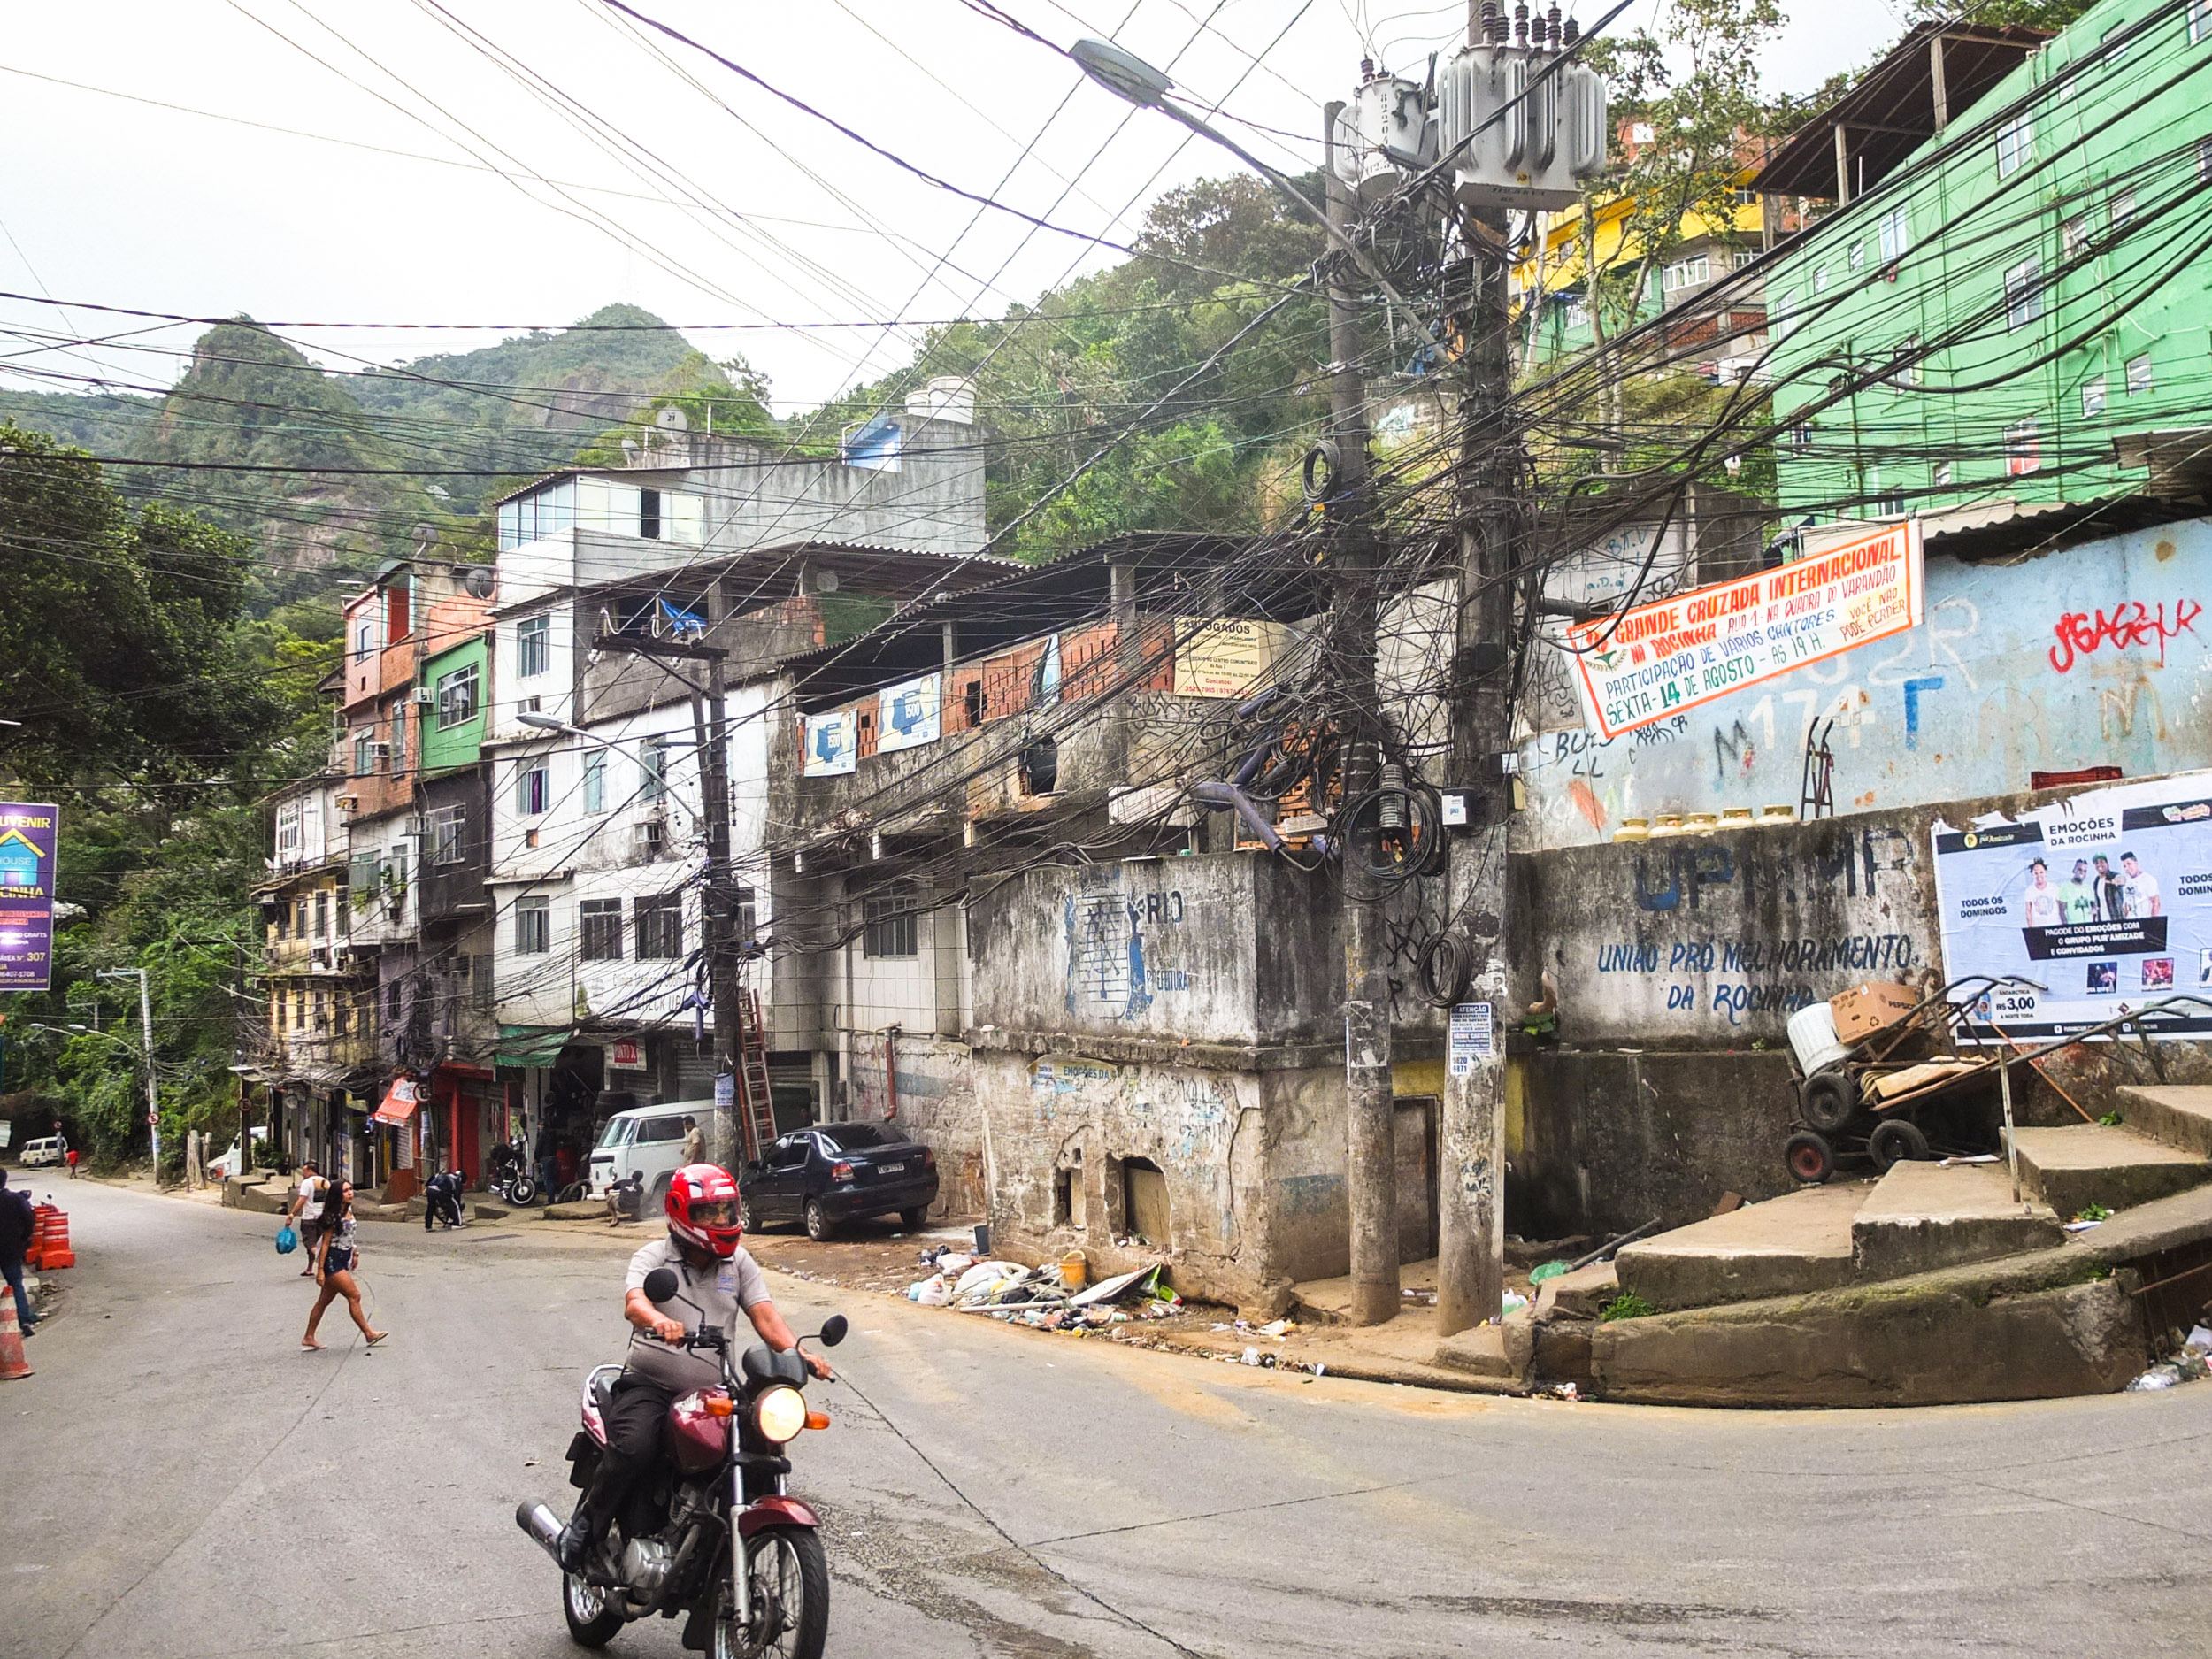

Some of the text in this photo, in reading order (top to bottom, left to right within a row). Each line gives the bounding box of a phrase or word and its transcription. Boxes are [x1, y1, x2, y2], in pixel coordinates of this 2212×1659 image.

[1614, 536, 1902, 645] GRANDE CRUZADA INTERNACIONAL
[1848, 587, 1898, 620] VOCÊ NÃO
[1630, 643, 1647, 665] NA
[1650, 622, 1717, 659] ROCINHA
[1727, 611, 1747, 634] RUA
[1766, 603, 1779, 624] NA
[1784, 590, 1821, 619] QUADRA
[1827, 586, 1838, 603] DO
[1841, 565, 1896, 599] VARANDÃO
[1839, 598, 1906, 642] PODE PERDER
[1605, 652, 1695, 700] PARTICIPAÇÃO
[1700, 645, 1717, 665] DE
[1718, 629, 1764, 657] VÁRIOS
[1659, 680, 1681, 710] 14
[1684, 674, 1699, 698] DE
[1702, 654, 1755, 691] AGOSTO
[1791, 635, 1808, 658] 19
[2049, 817, 2115, 835] EMOÇÕES
[2050, 831, 2116, 847] DA ROCINHA
[1147, 889, 1183, 925] RIO
[1961, 895, 2004, 908] TODOS OS
[1960, 906, 2008, 918] DOMINGOS
[2044, 921, 2140, 937] PAGODE DO EMOÇÕES COM
[2064, 936, 2092, 945] GRUPO
[27, 951, 46, 962] 307
[1669, 934, 1715, 973] PRÓ
[2055, 944, 2105, 956] CONVIDADOS
[1145, 969, 1189, 992] PEFEITURA
[1667, 985, 1694, 1010] DA
[2007, 996, 2035, 1012] 3,00
[1458, 1005, 1487, 1014] ATENÇÃO
[1098, 1069, 1110, 1079] DA
